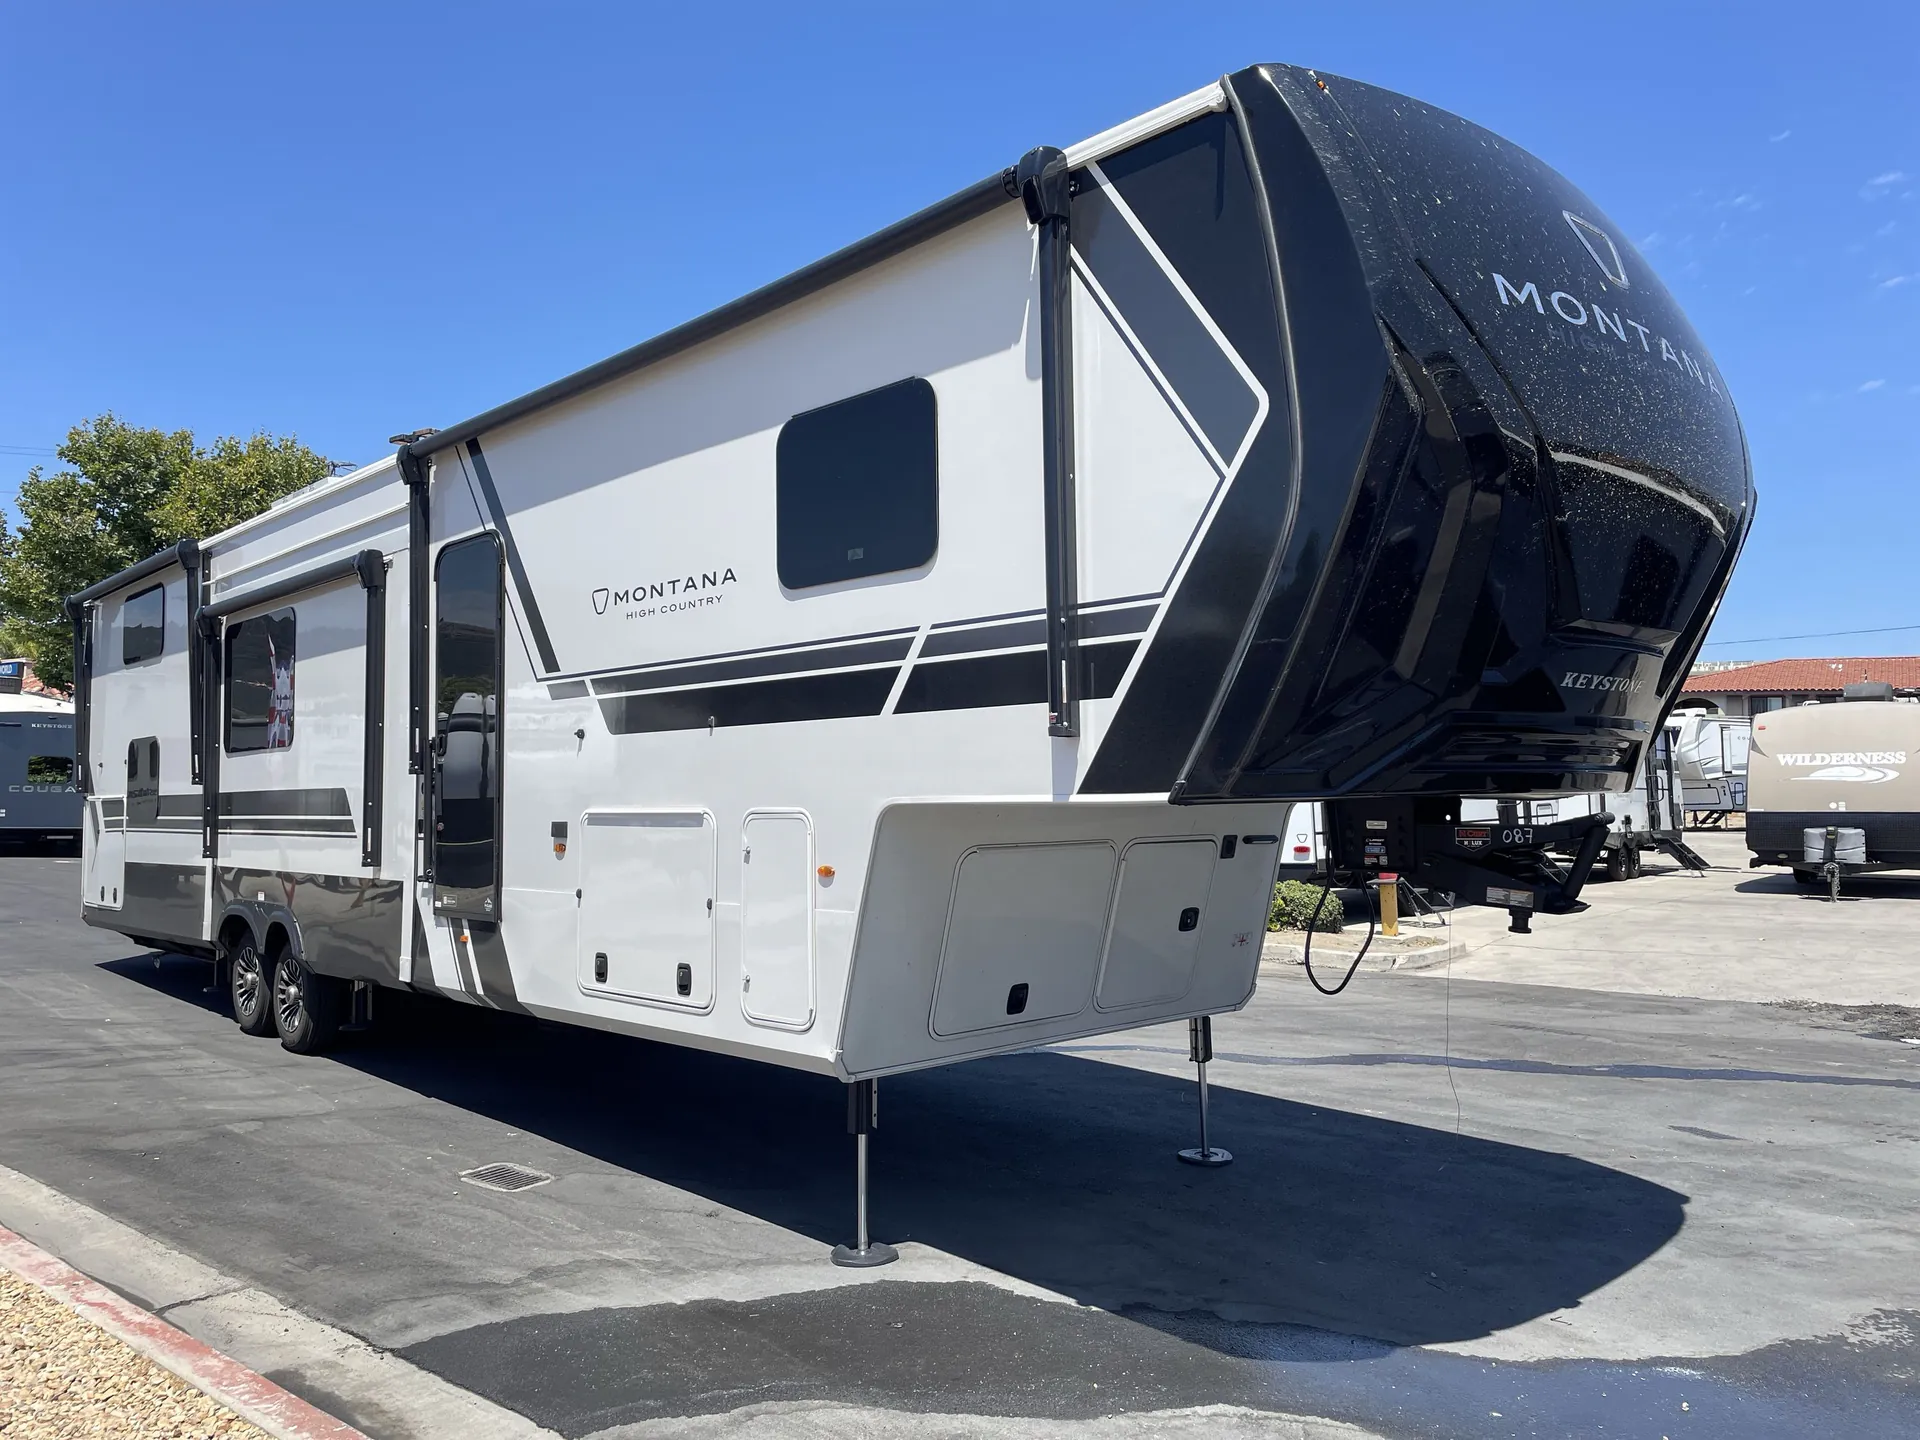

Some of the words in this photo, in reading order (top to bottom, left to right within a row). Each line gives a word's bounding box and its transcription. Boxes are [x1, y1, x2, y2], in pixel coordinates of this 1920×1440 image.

[1492, 272, 1724, 402] MONTANA
[614, 568, 737, 606] MONTANA
[626, 607, 656, 620] HIGH
[660, 594, 723, 614] COUNTRY
[0, 664, 13, 675] ORLD
[1560, 671, 1646, 694] KEYSTONE
[1776, 751, 1907, 766] WILDERNESS
[8, 785, 76, 793] COUGA
[1502, 828, 1533, 844] 087
